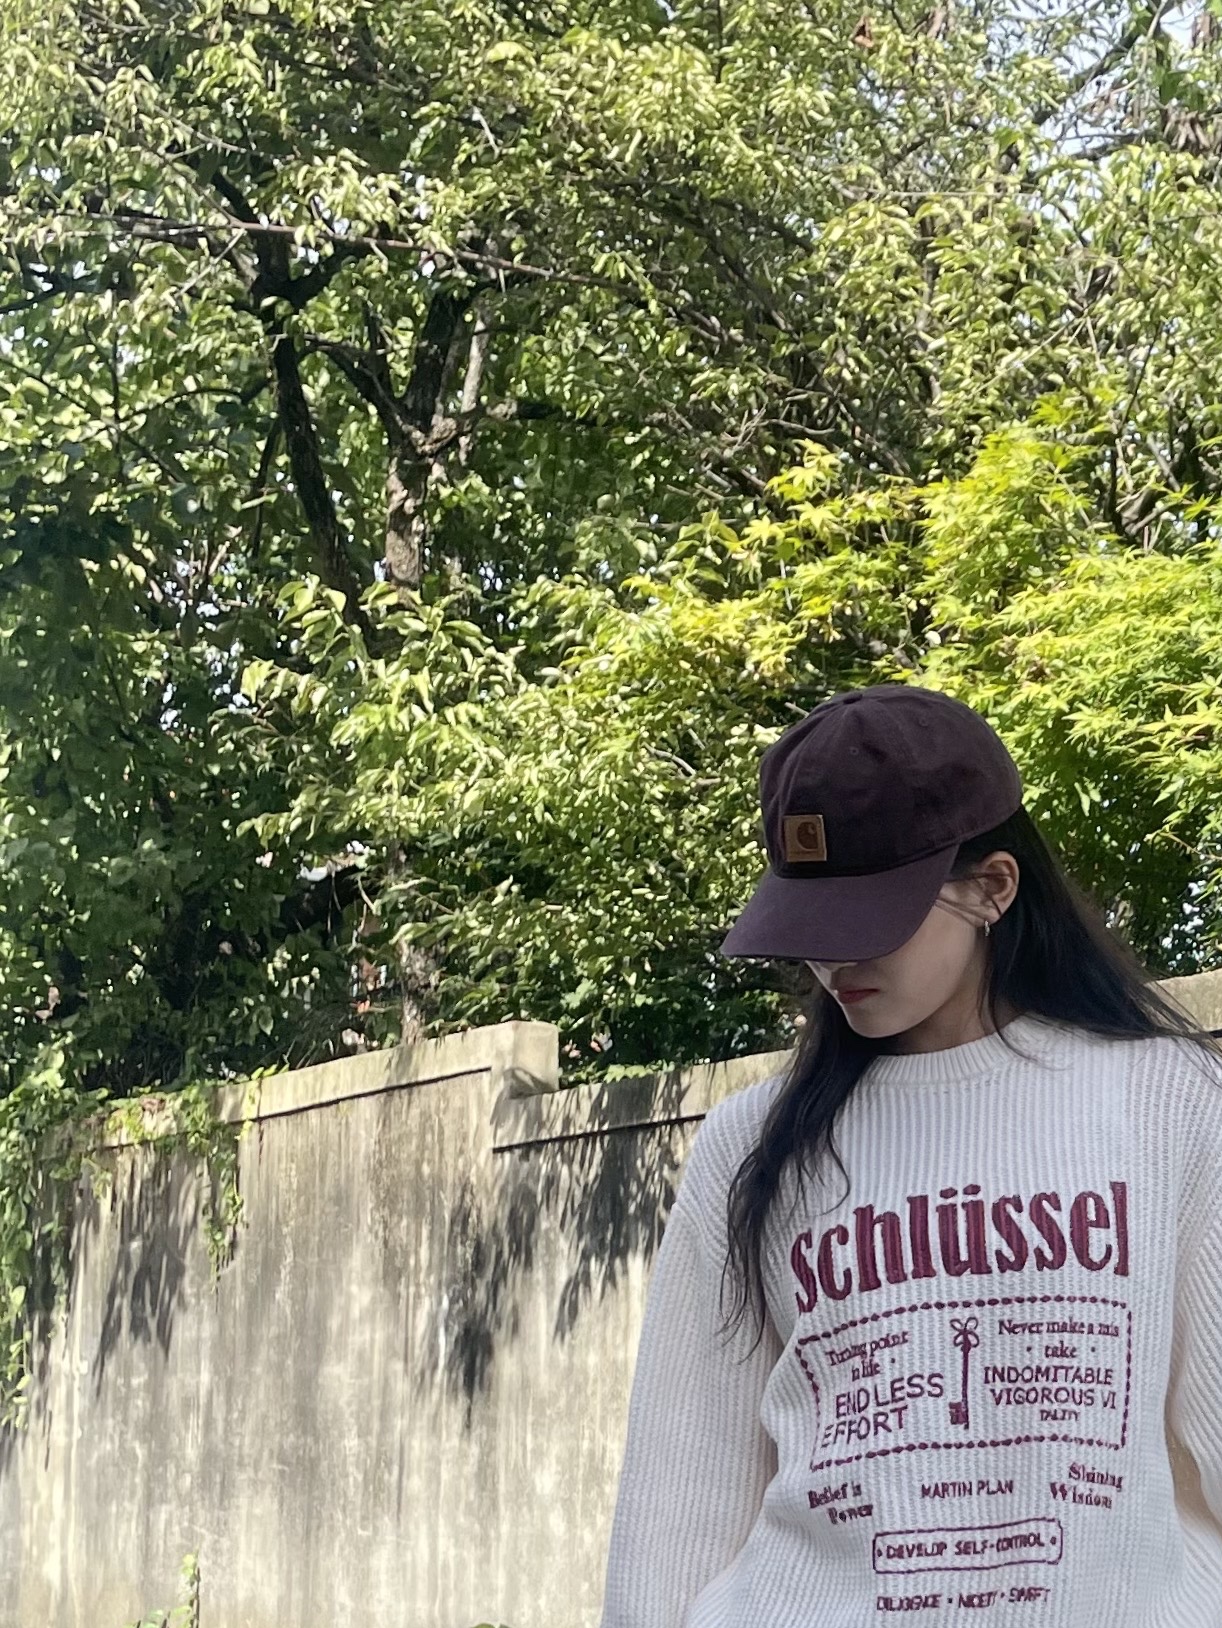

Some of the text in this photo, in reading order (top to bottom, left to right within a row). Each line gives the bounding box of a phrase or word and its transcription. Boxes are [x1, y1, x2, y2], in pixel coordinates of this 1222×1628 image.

[1044, 1340, 1077, 1358] take
[983, 1365, 1114, 1385] INDOMITABLE
[835, 1373, 944, 1419] ENDLESS
[989, 1387, 1095, 1407] VIGOROUS
[820, 1405, 908, 1448] EFFORT
[921, 1480, 1014, 1499] MARTIN PLAN
